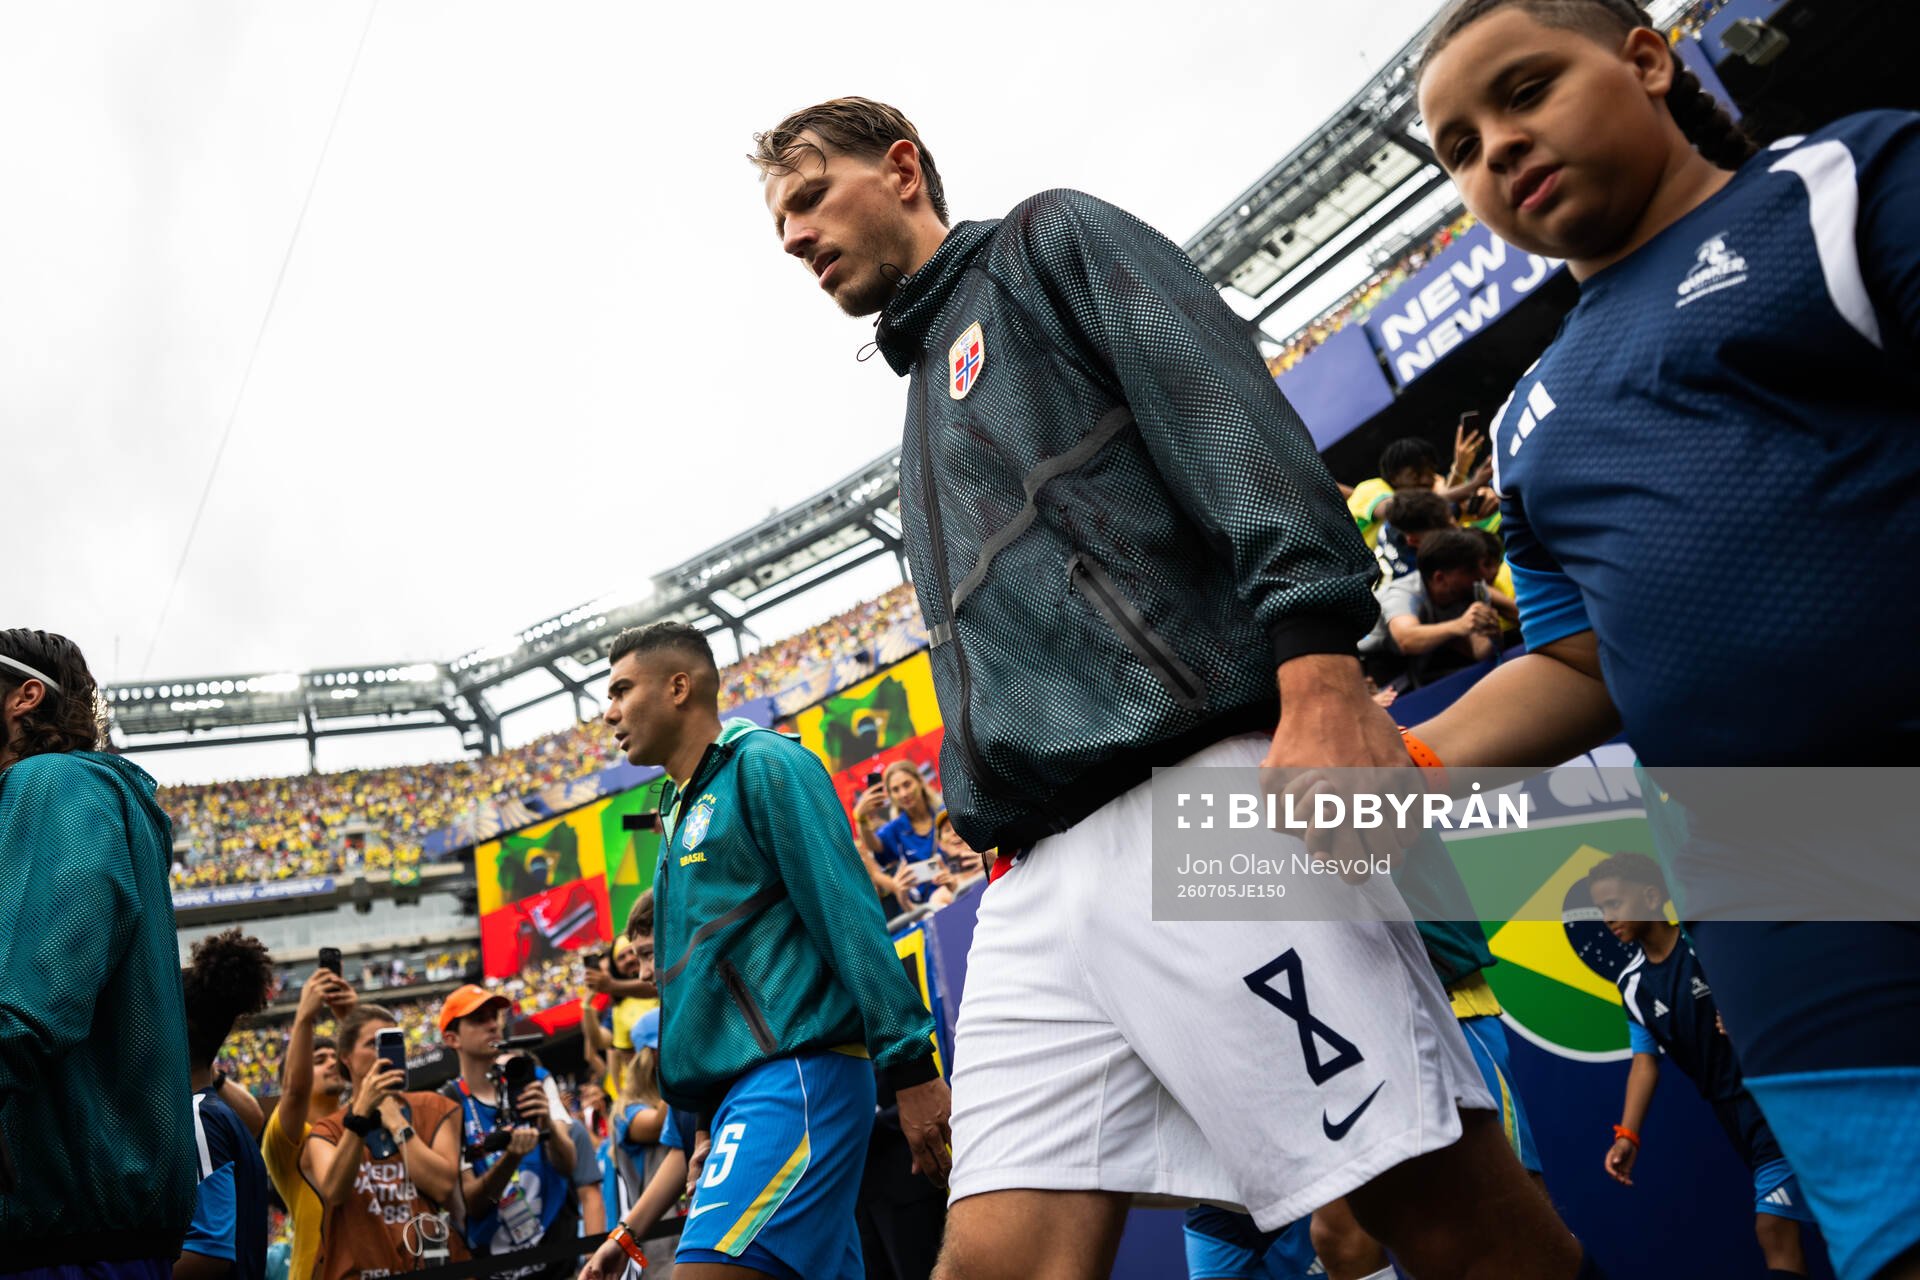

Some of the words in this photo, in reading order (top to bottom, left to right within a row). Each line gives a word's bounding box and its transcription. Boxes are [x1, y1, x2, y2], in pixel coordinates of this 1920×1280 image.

[1381, 232, 1507, 351] NEW
[1396, 282, 1500, 382] NEW
[1243, 948, 1365, 1087] 8
[703, 1123, 747, 1188] 5
